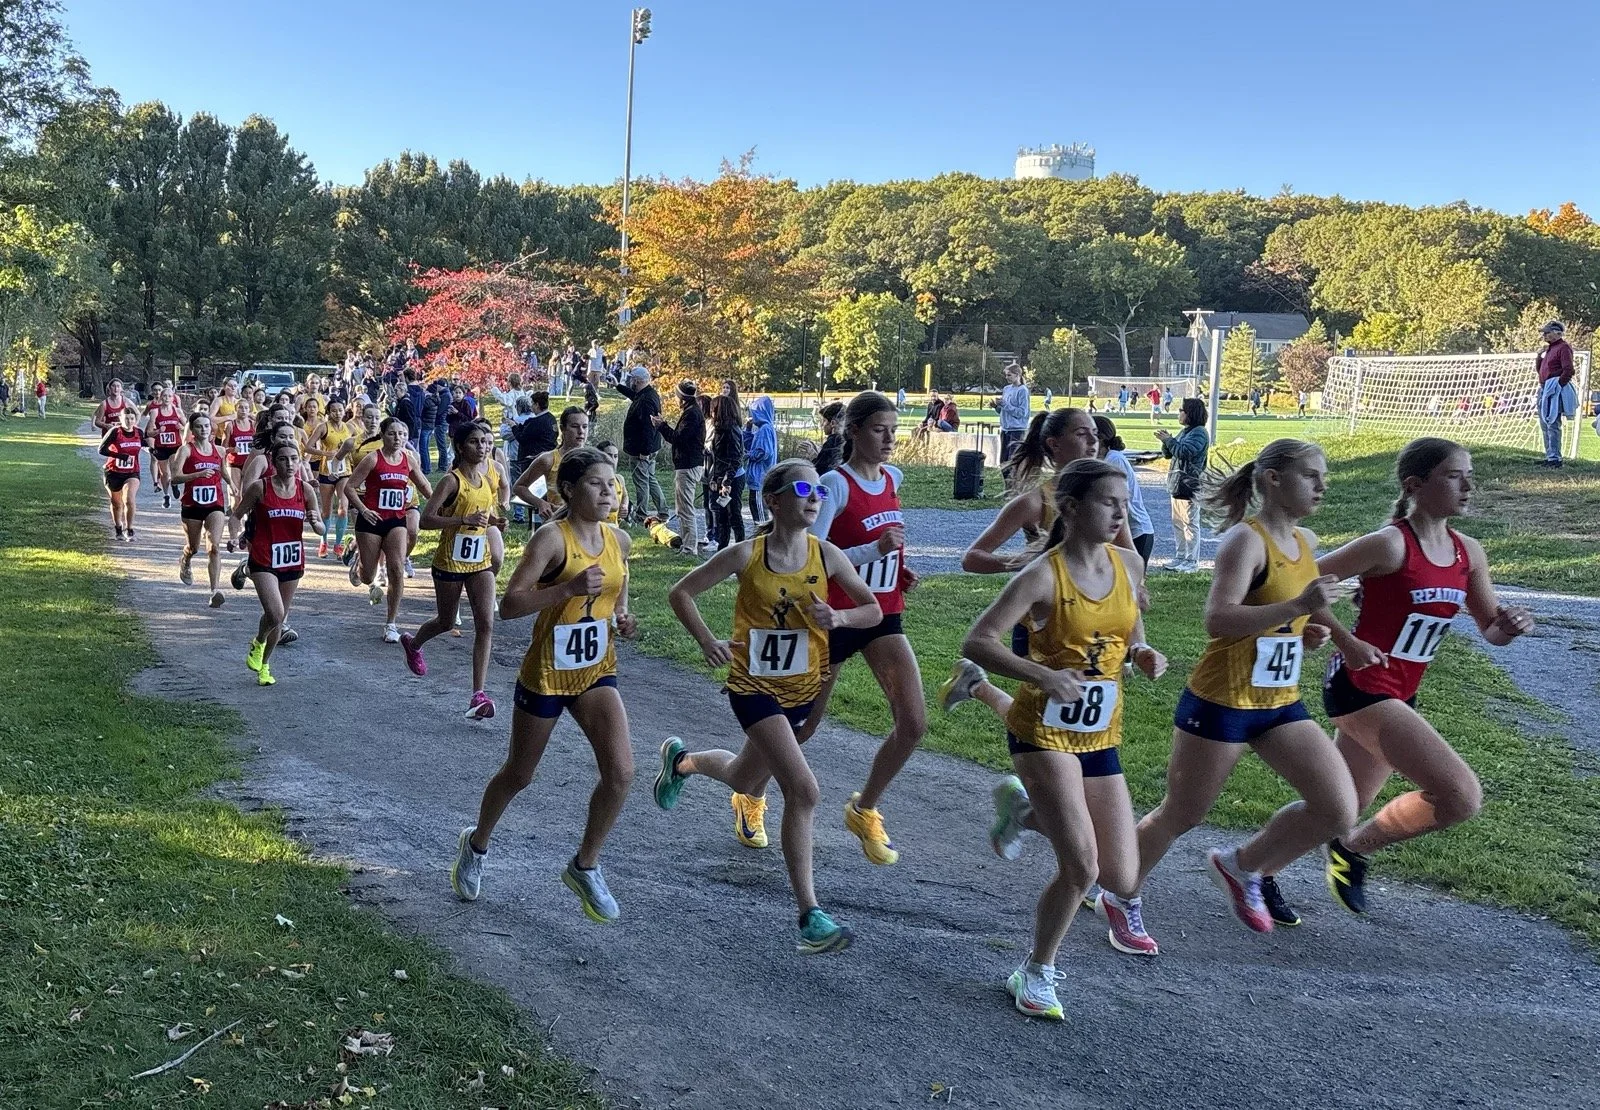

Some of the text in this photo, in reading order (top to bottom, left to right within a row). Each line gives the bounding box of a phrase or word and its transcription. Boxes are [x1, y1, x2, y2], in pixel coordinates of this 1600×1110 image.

[161, 433, 175, 443] 120
[194, 487, 216, 502] 107
[381, 490, 403, 508] 109
[268, 508, 305, 520] READING
[274, 543, 300, 565] 105
[460, 536, 481, 560] 61
[864, 553, 899, 588] 117
[565, 625, 599, 664] 46
[760, 632, 799, 671] 47
[1266, 640, 1297, 682] 45
